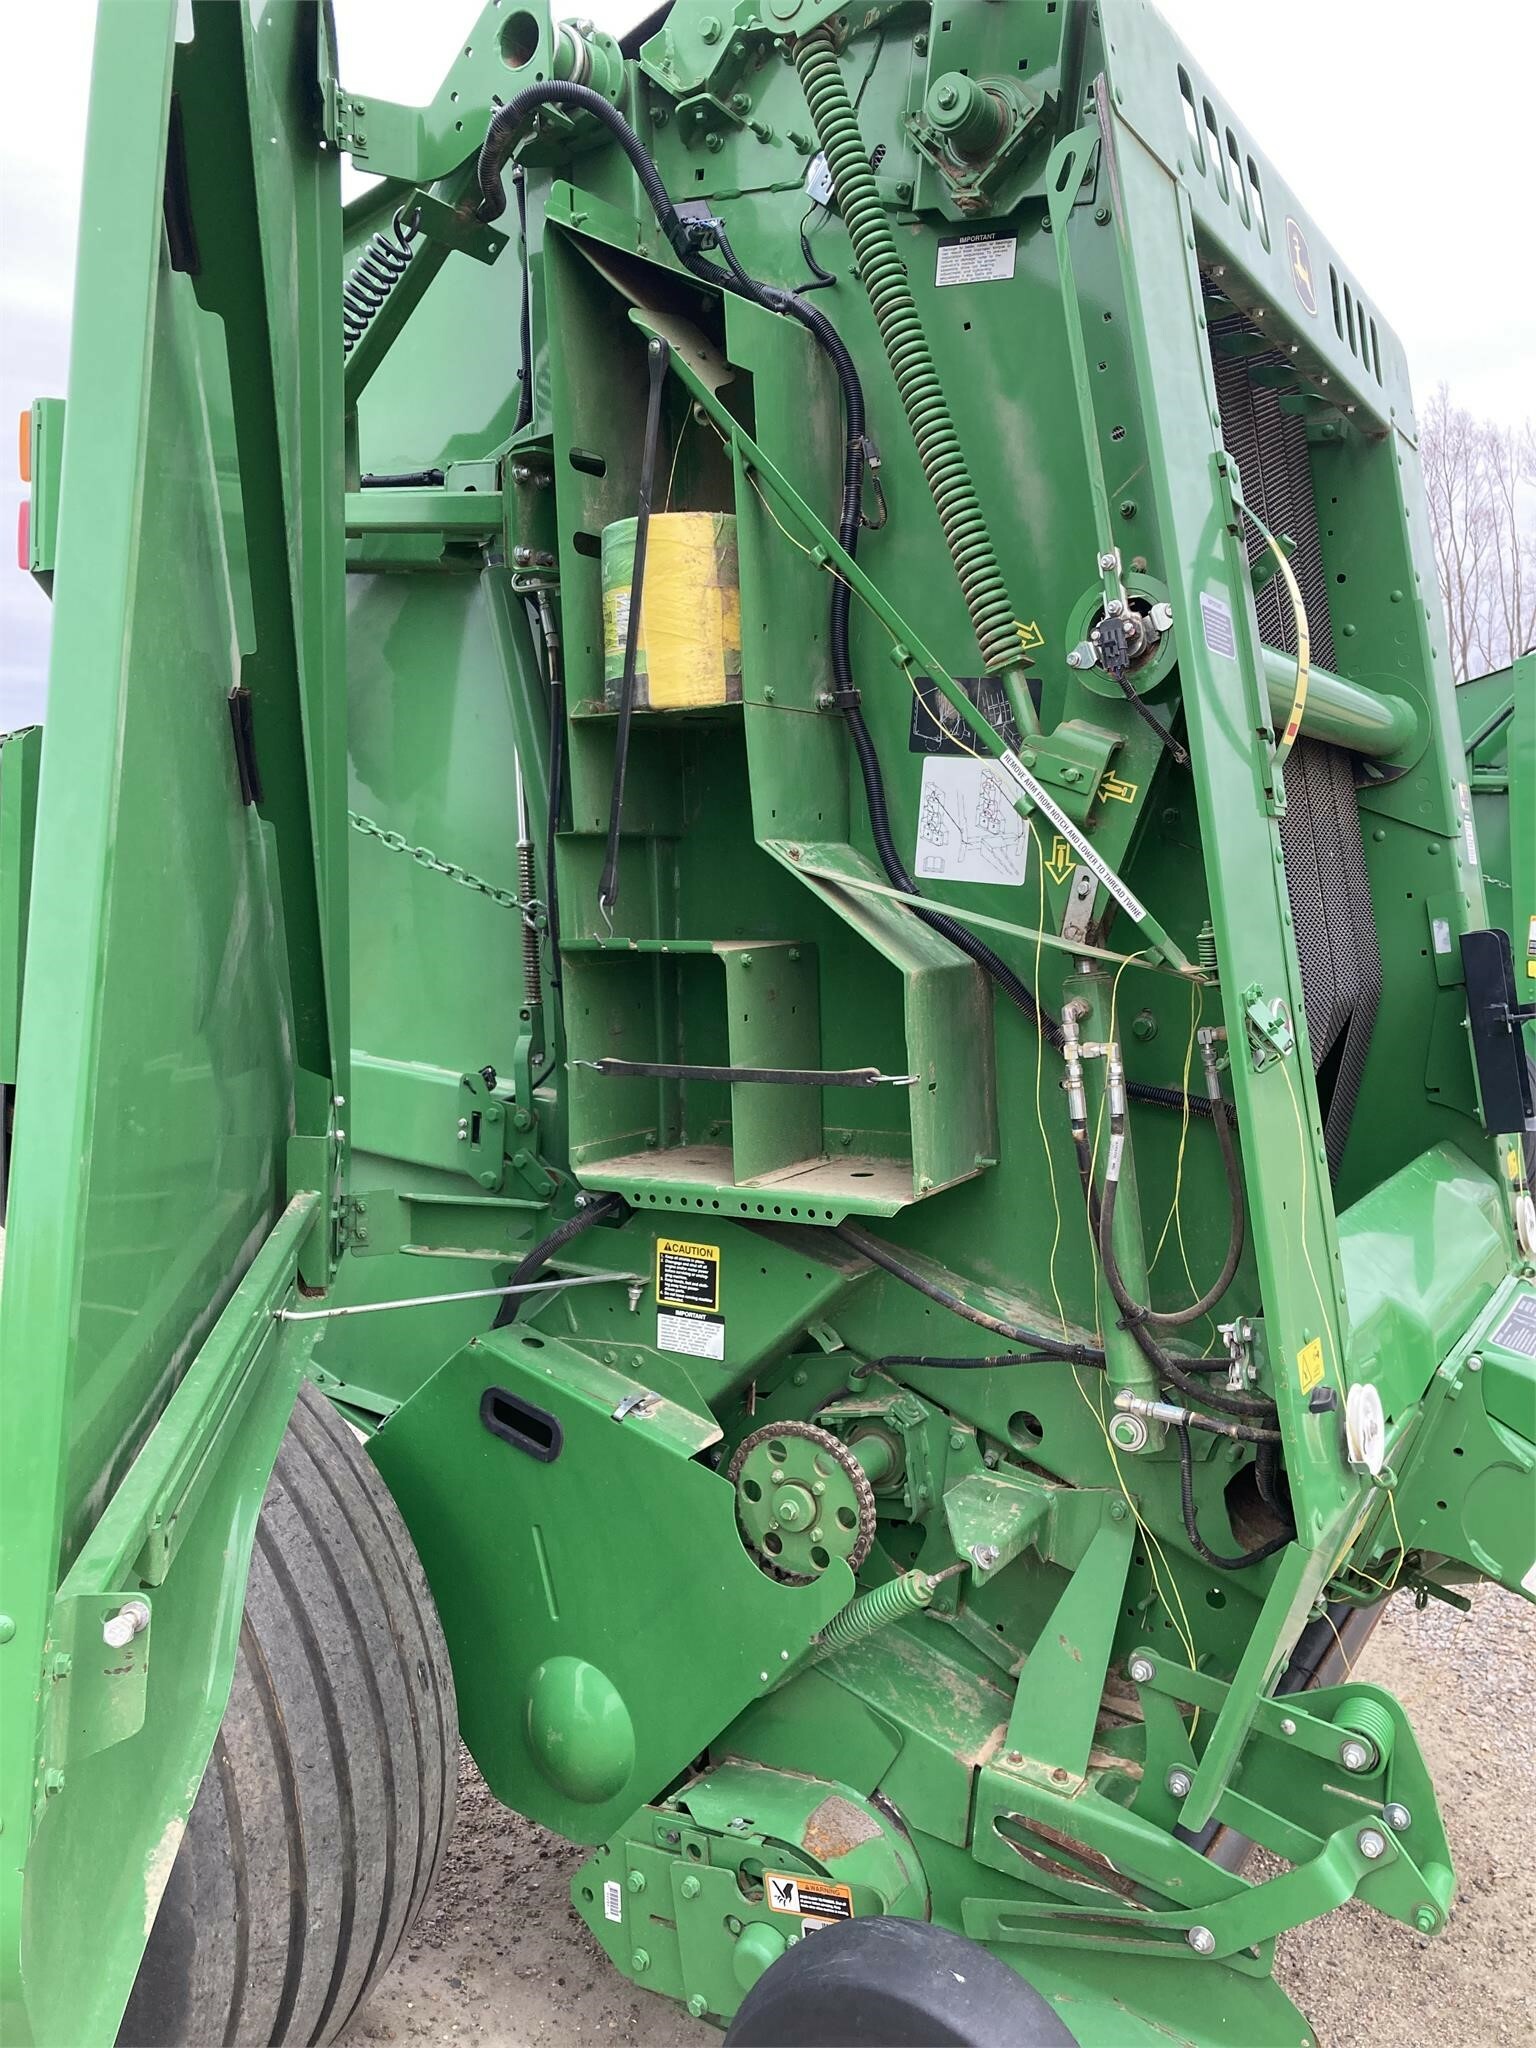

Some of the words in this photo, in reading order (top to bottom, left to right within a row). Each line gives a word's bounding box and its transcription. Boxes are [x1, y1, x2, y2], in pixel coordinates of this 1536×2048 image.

[959, 233, 996, 243] IMPORTANT
[1003, 753, 1026, 780] REMOVE
[1022, 777, 1037, 794] ARM
[1034, 791, 1053, 812] FROM
[1049, 809, 1070, 832] NOTCH
[1066, 829, 1081, 845] AND
[1077, 842, 1099, 867] LOWER
[1095, 864, 1106, 875] TO
[1102, 872, 1126, 899] THREAD
[1122, 896, 1143, 919] TWINE
[672, 1243, 713, 1257] CAUTION
[675, 1309, 707, 1320] IMPORTANT
[810, 1885, 841, 1896] WARNING
